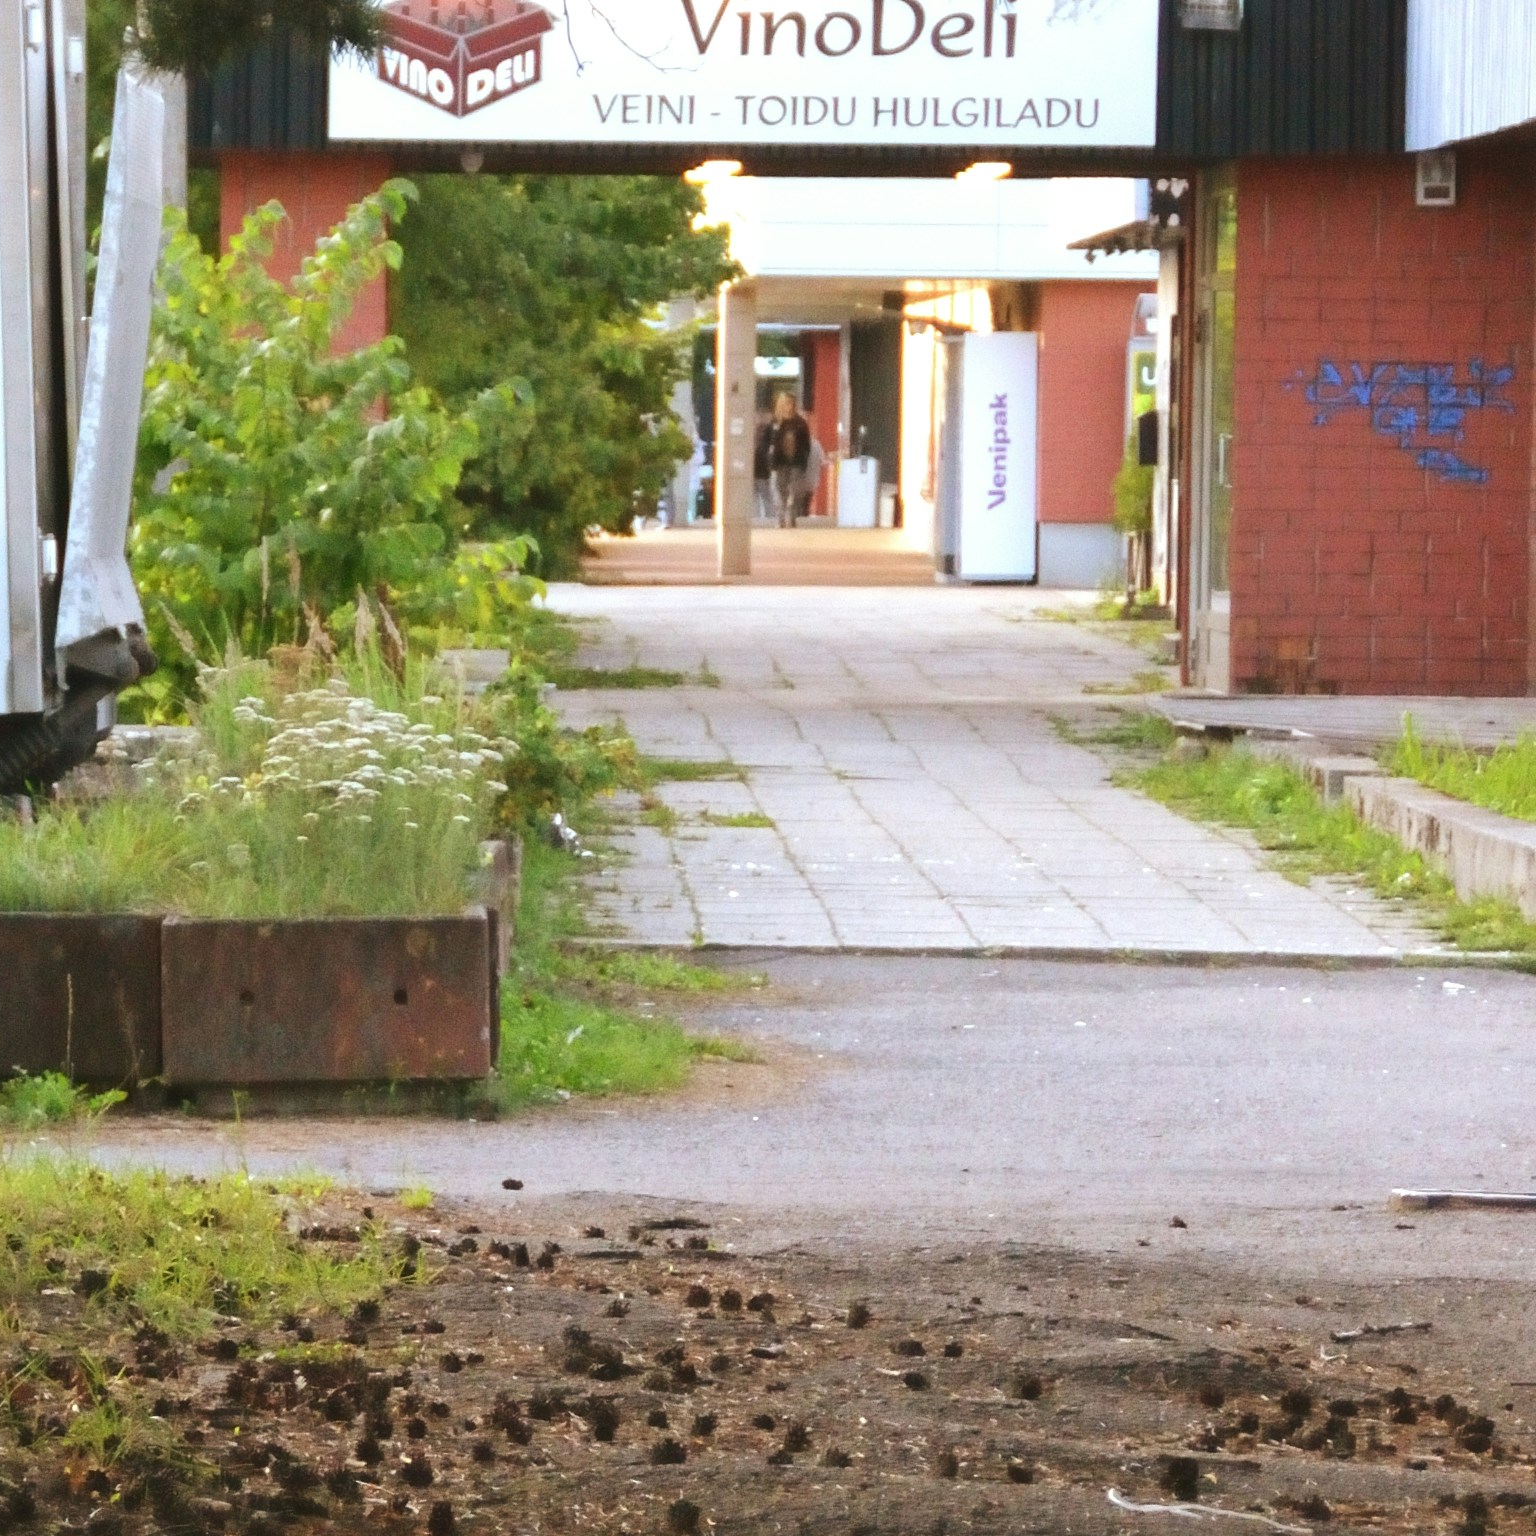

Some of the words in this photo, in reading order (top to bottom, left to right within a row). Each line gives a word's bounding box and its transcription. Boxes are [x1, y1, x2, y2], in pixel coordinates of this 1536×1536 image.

[466, 49, 535, 105] DELI
[592, 93, 695, 125] VEINI
[735, 95, 857, 126] TOIDU
[873, 96, 1100, 129] HULGILADU
[987, 392, 1011, 510] Venipak
